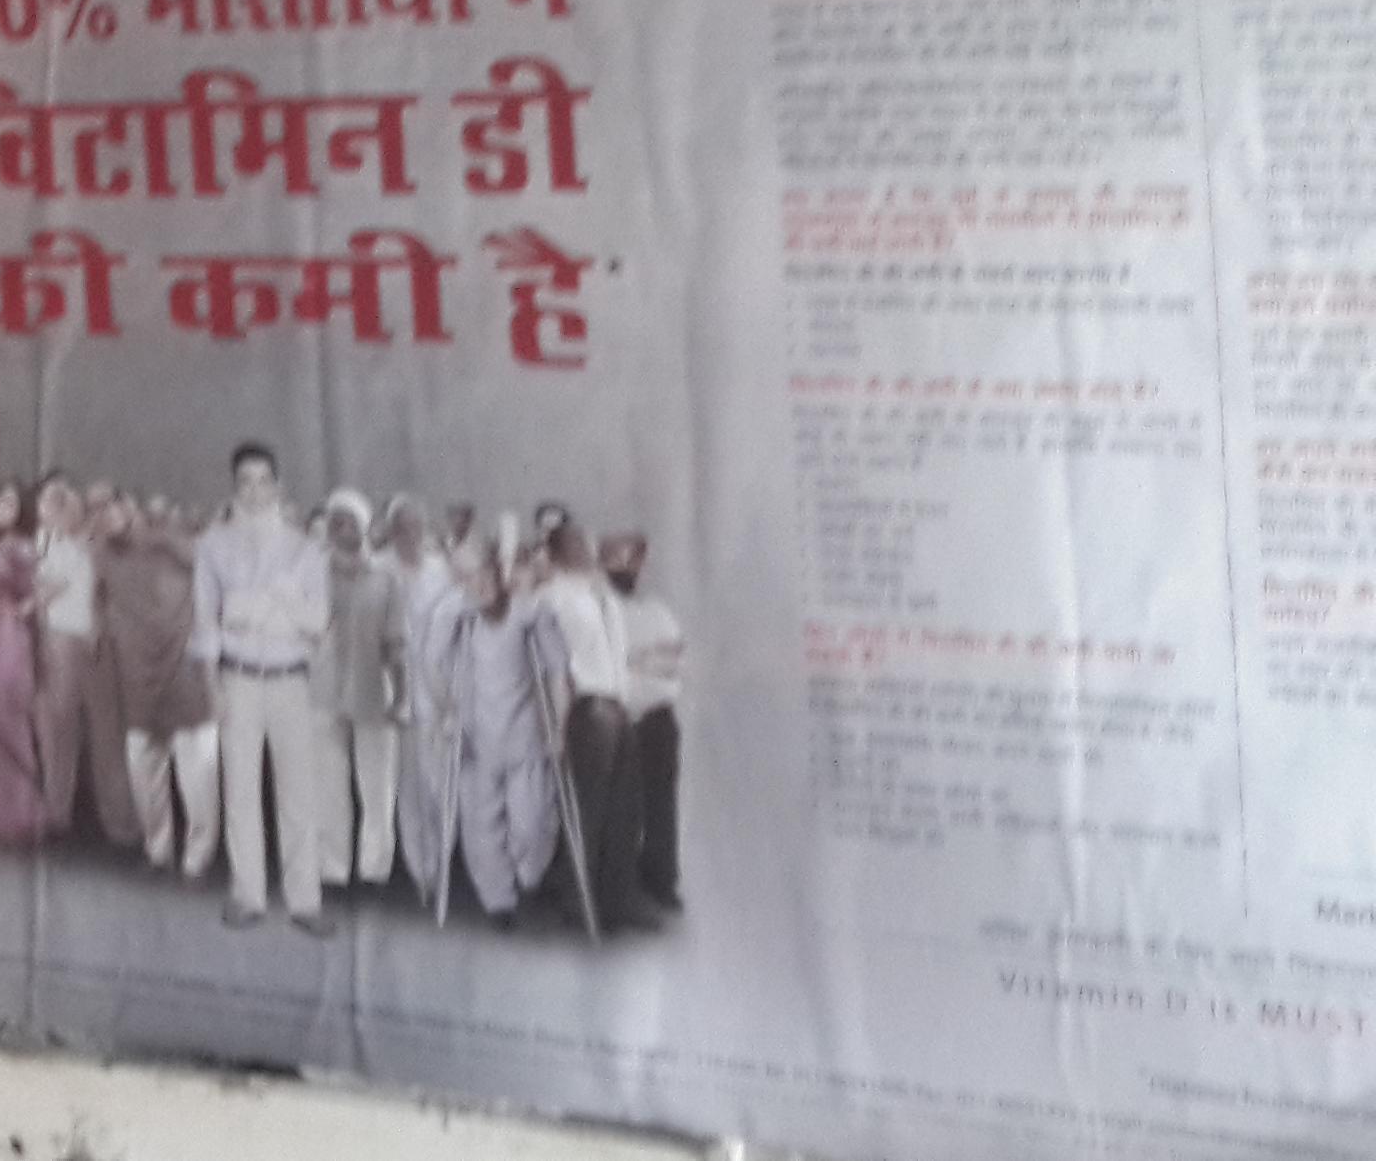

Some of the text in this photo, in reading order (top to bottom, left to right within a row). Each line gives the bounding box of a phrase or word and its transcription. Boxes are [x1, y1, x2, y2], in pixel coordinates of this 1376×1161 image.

[450, 55, 592, 195] डी
[160, 229, 456, 345] कमी
[482, 225, 594, 369] है
